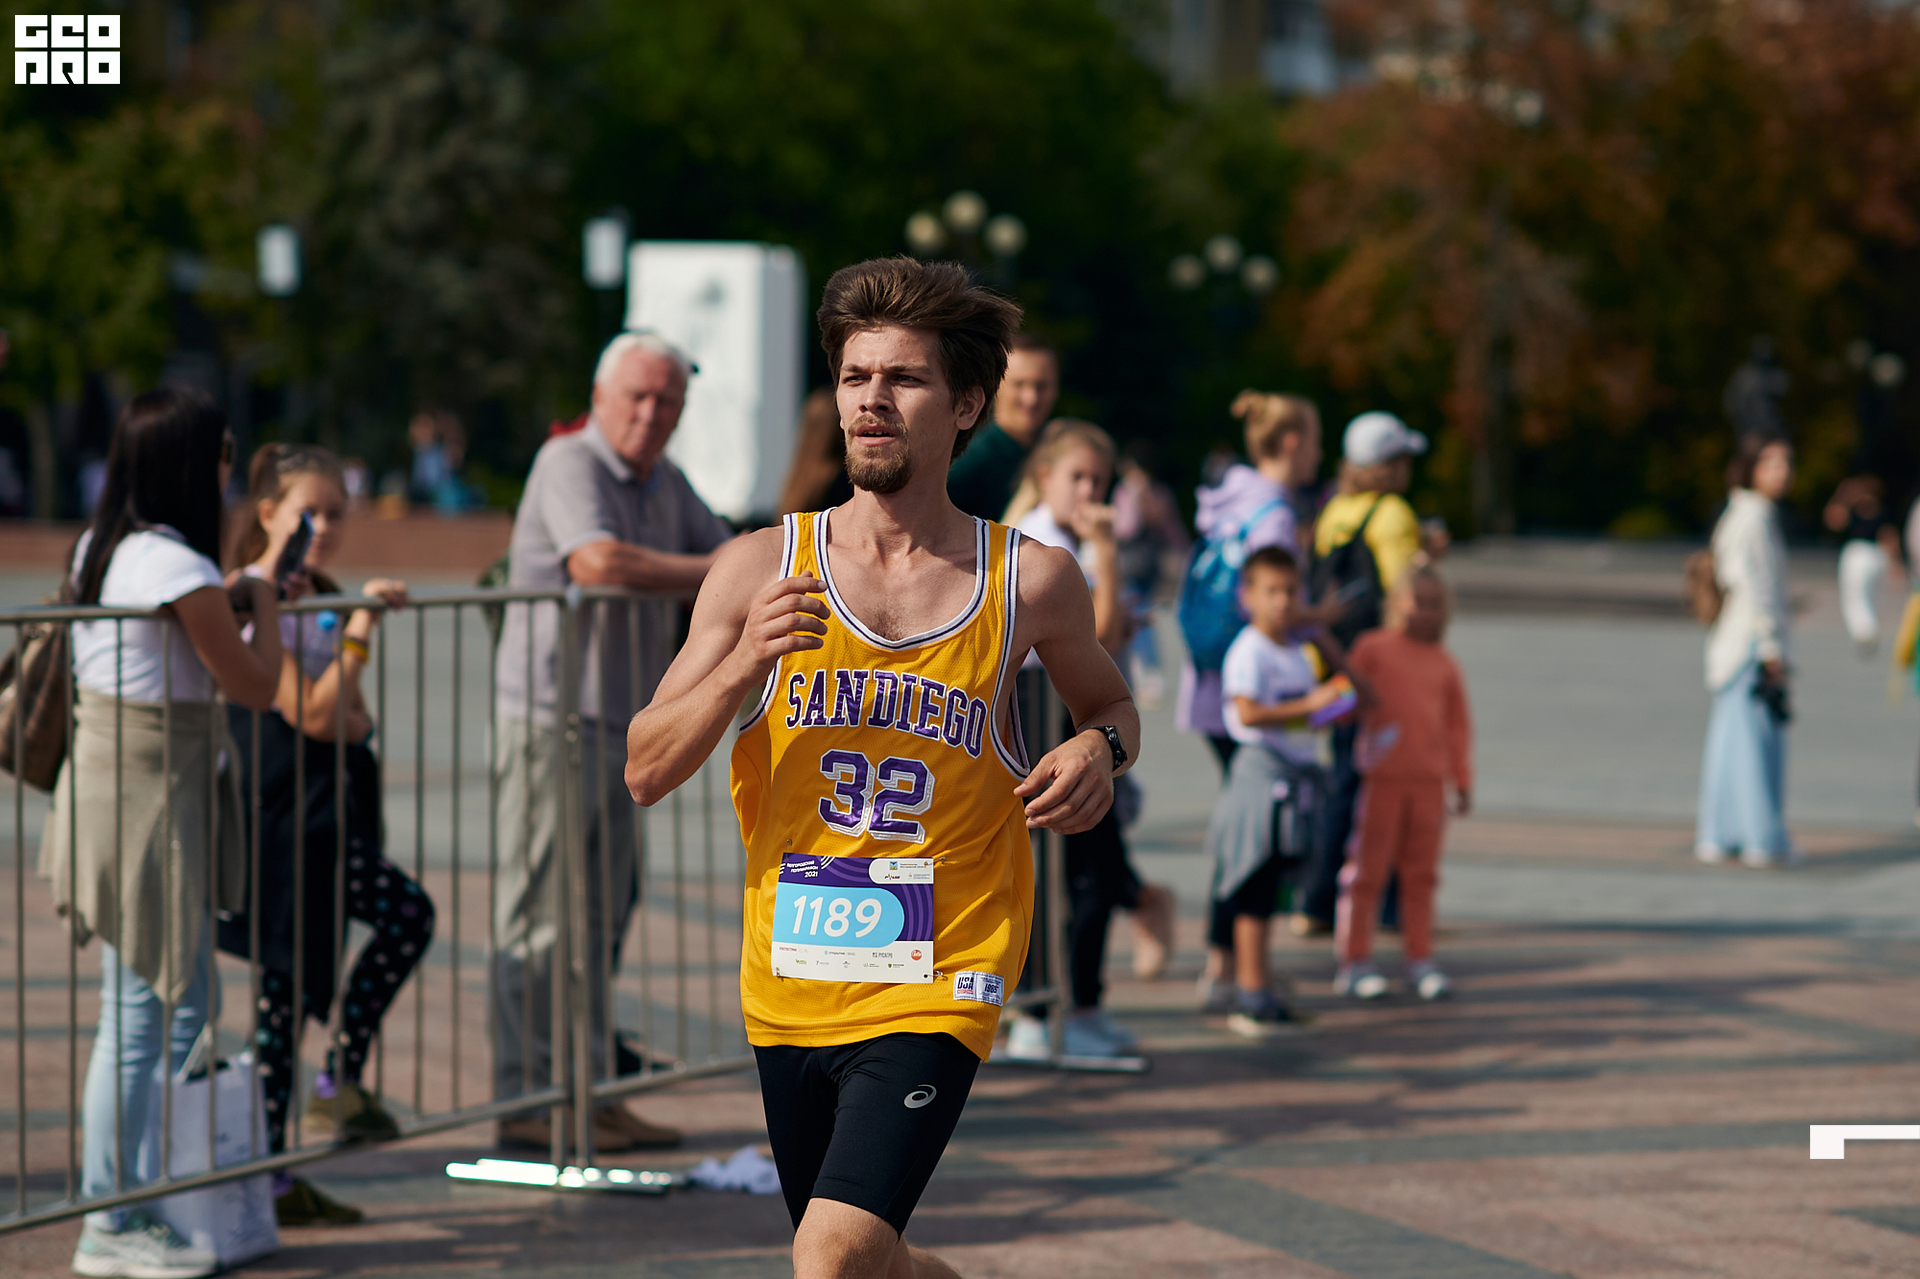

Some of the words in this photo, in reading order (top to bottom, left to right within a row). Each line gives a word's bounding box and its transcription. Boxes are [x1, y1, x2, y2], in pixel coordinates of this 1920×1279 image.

[786, 669, 869, 729] SAN
[867, 669, 988, 759] DIEGO
[818, 749, 935, 844] 32
[793, 895, 882, 938] 1189
[957, 976, 974, 990] USA
